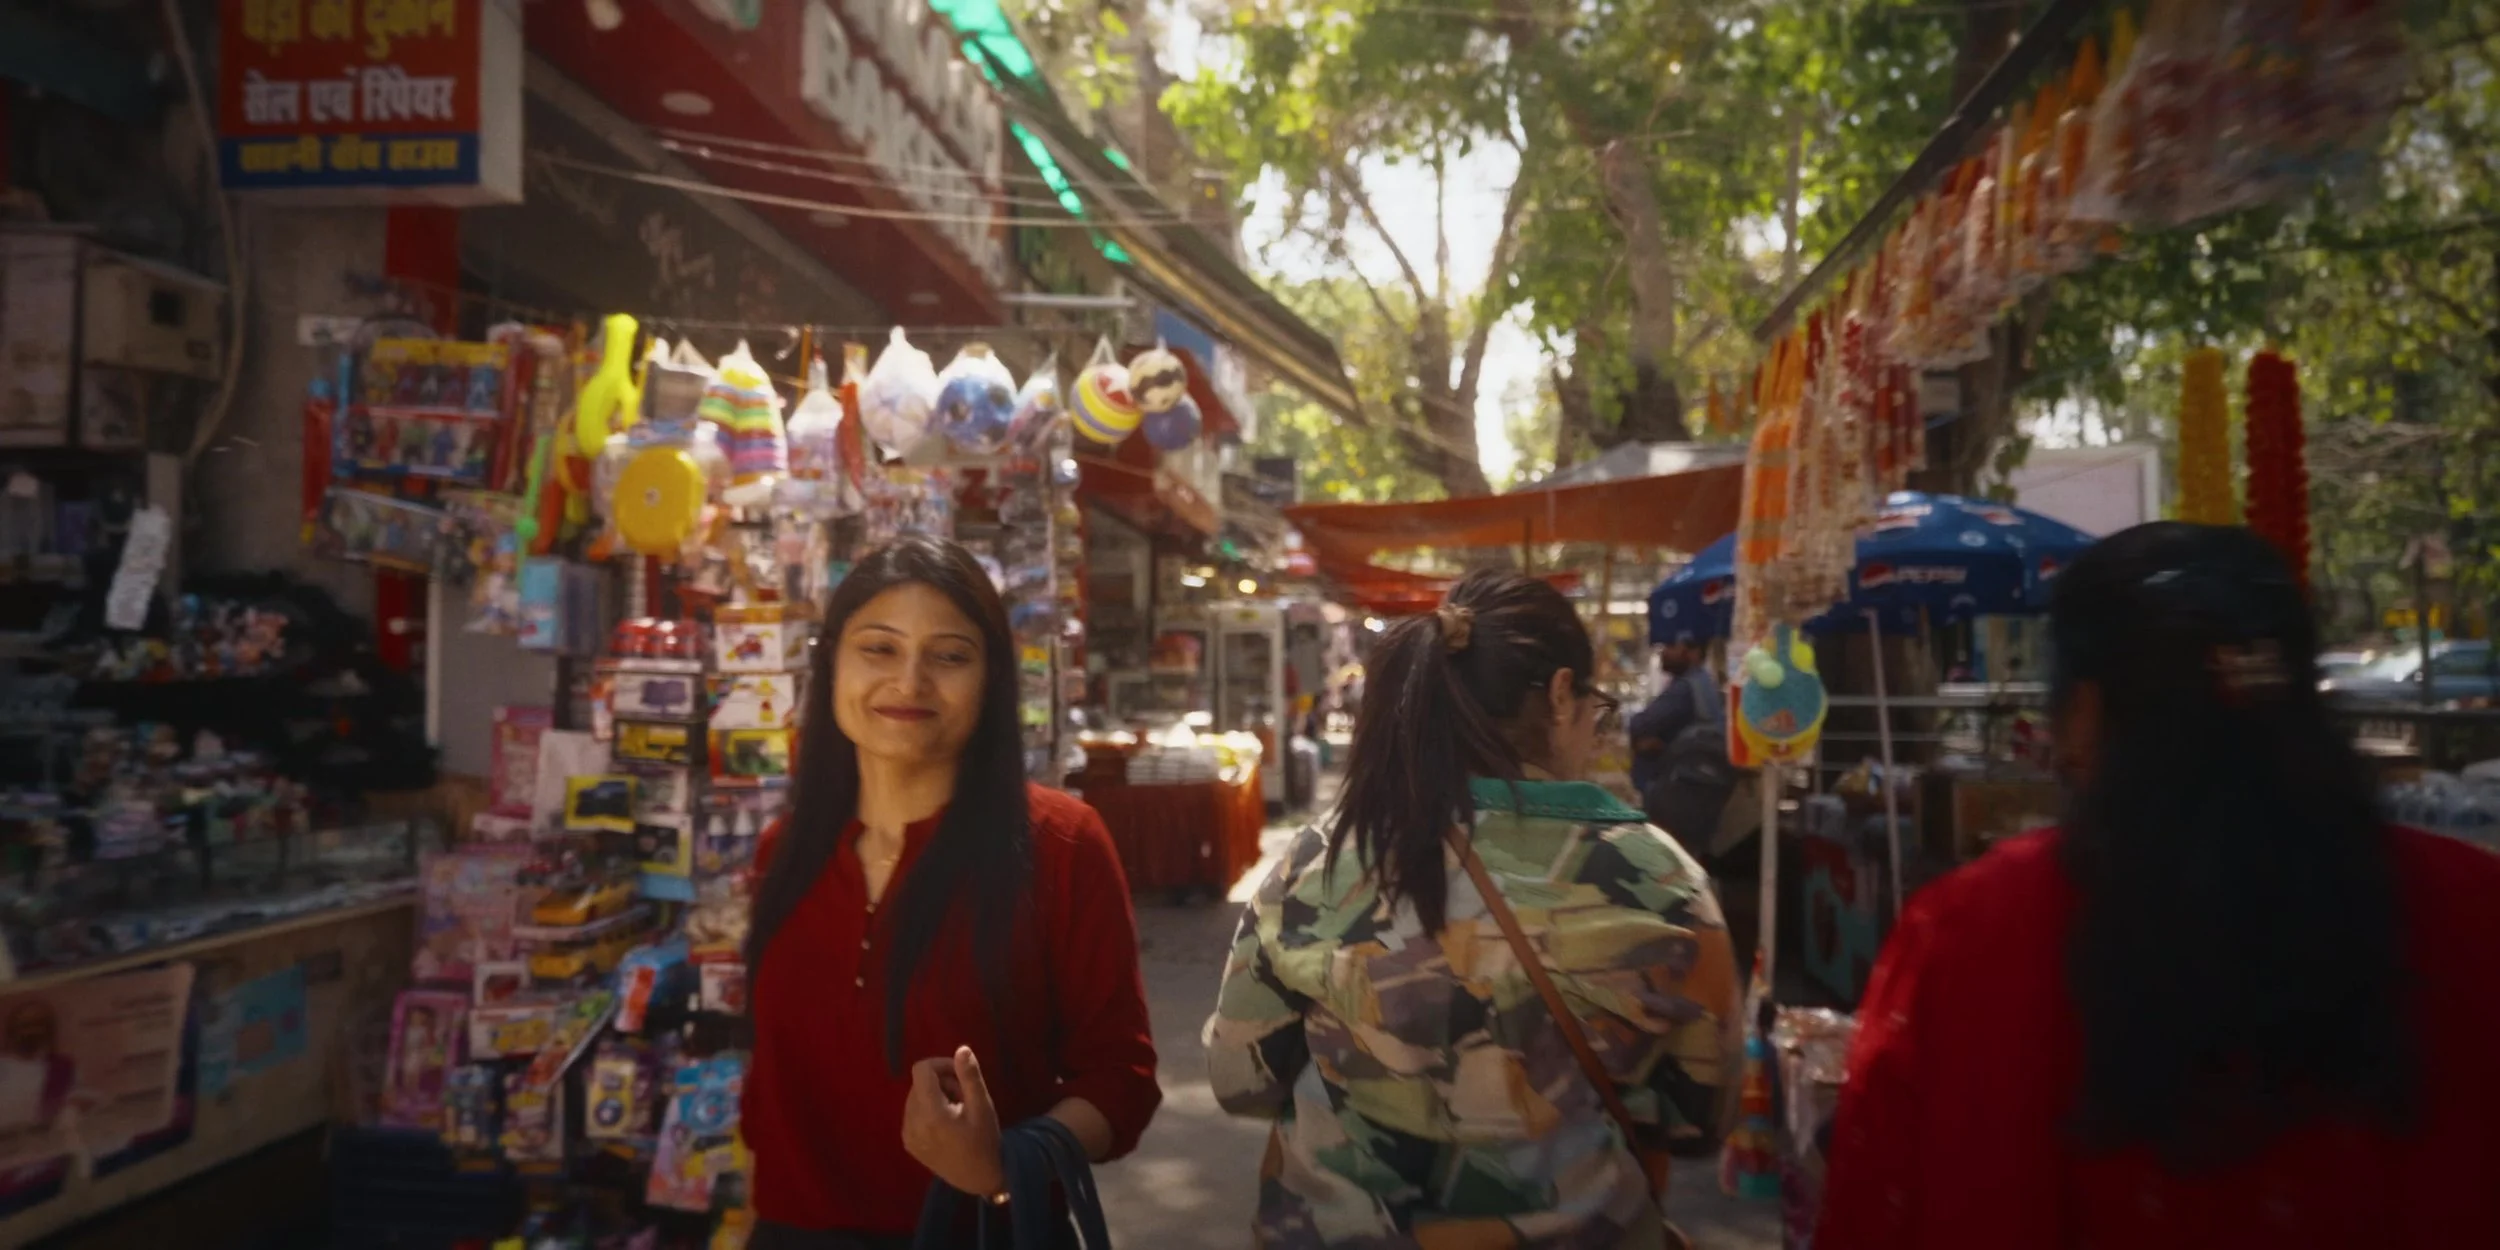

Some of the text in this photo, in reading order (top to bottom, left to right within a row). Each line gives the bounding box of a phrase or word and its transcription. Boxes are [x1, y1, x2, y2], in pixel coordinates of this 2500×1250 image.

[244, 64, 456, 123] सेल एवं रिपेयर
[1895, 565, 1968, 584] PEPSI
